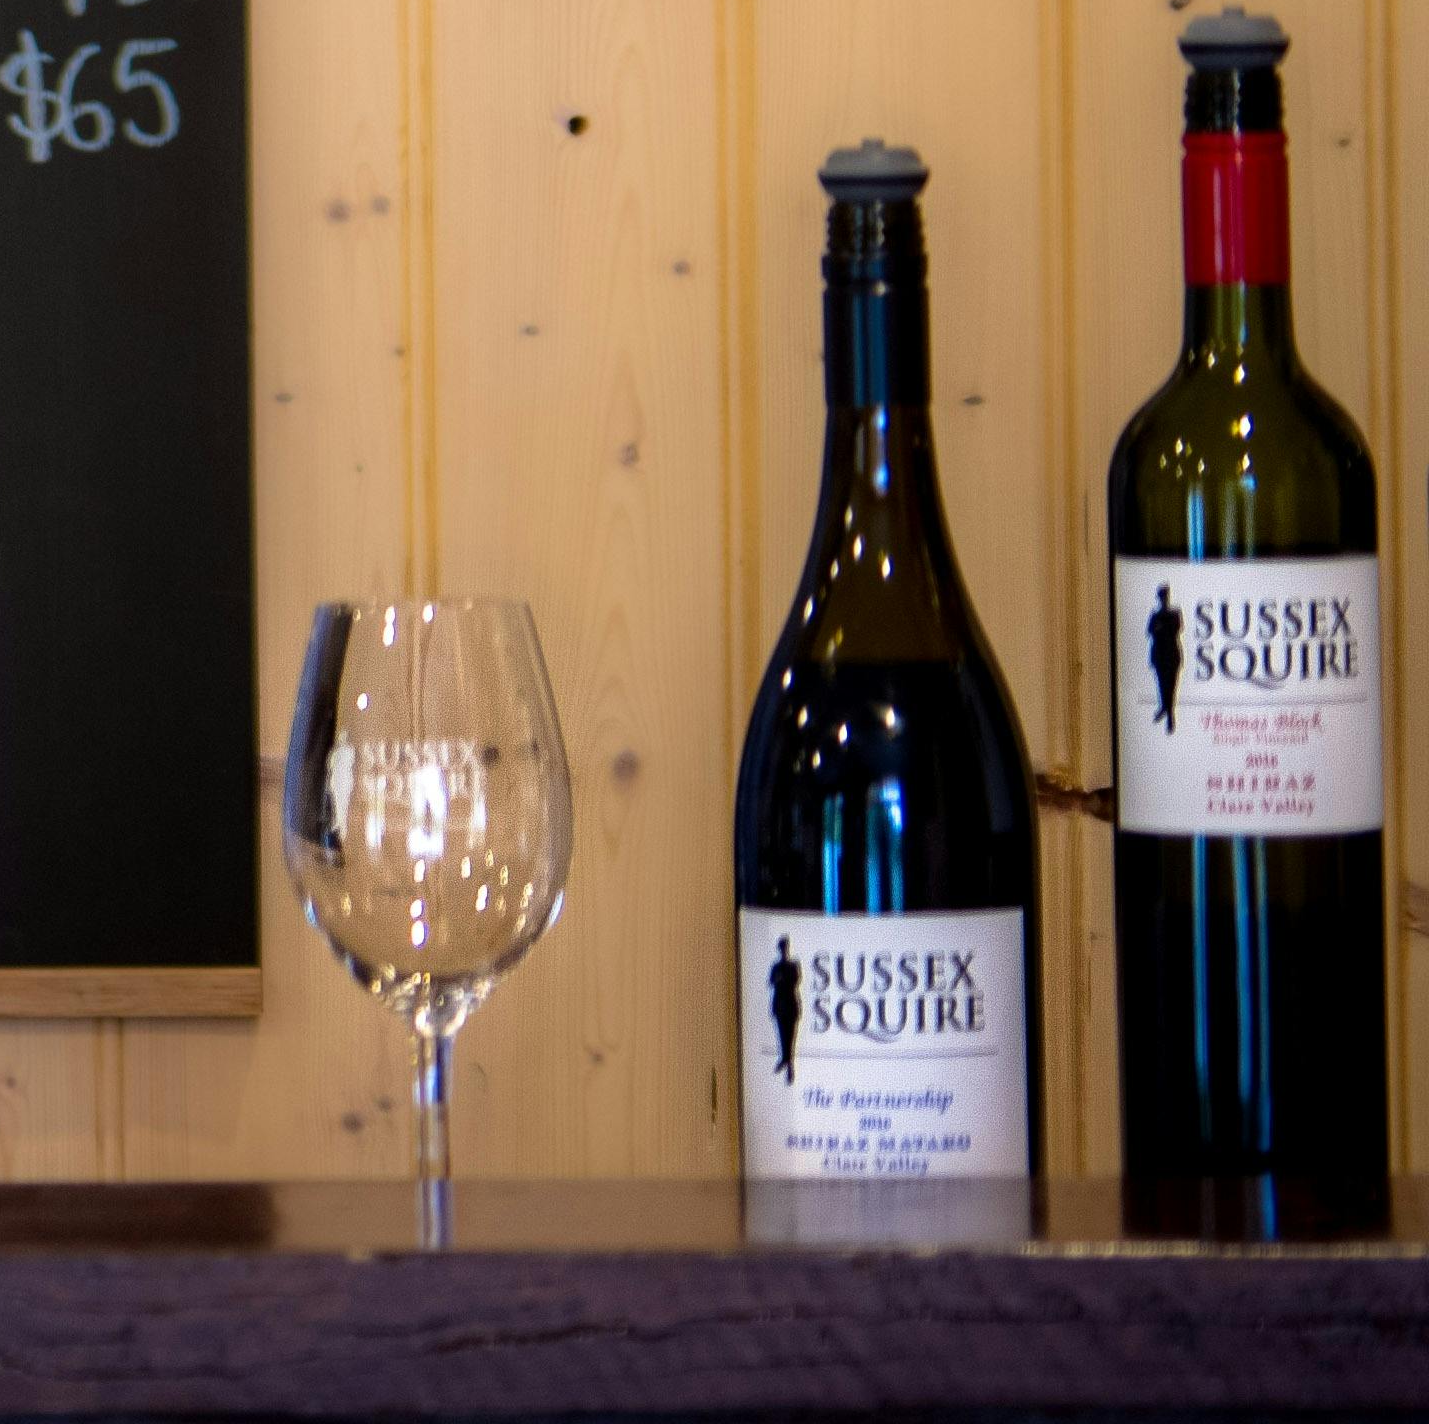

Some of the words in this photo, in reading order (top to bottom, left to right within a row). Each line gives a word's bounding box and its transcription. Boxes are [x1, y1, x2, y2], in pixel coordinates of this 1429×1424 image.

[1194, 597, 1351, 639] SUSSEX
[1194, 640, 1359, 690] SQUIRE
[812, 950, 974, 993] SUSSEX
[812, 994, 986, 1043] SQUIRE
[803, 1087, 833, 1108] The
